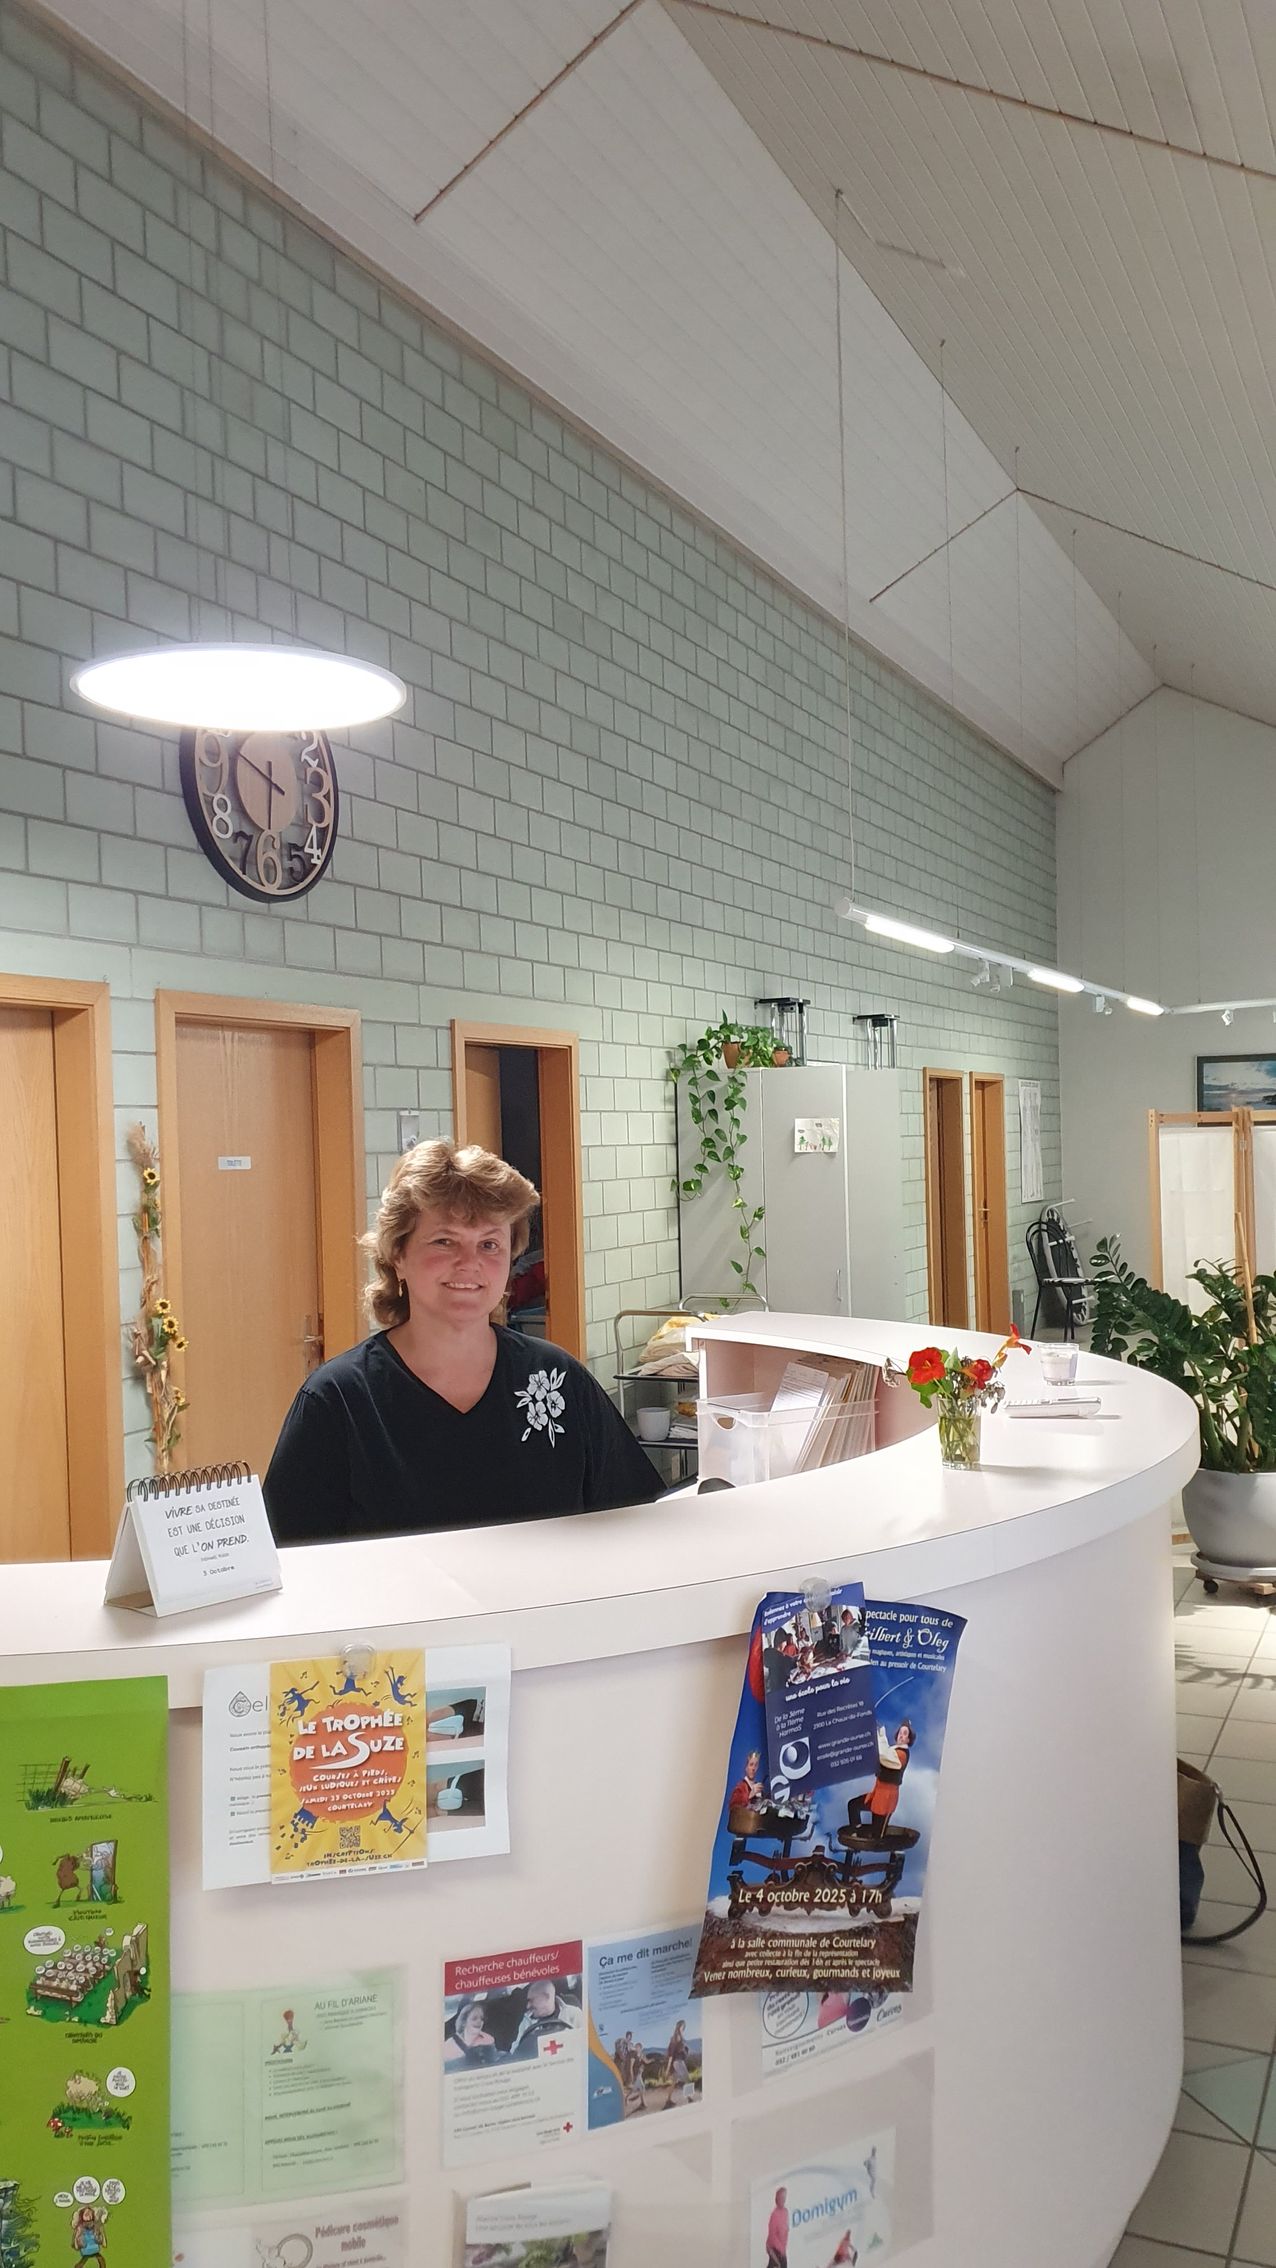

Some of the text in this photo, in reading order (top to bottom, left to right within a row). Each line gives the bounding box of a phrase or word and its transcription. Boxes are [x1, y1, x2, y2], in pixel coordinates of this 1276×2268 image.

[198, 731, 229, 795] 9
[305, 768, 332, 828] 3
[212, 794, 233, 839] 8
[233, 831, 253, 875] 7
[304, 825, 322, 864] 4
[256, 831, 282, 889] 6
[288, 842, 306, 882] 5
[195, 1504, 206, 1514] SA
[208, 1496, 241, 1511] DESTINÉE
[167, 1514, 246, 1538] EST UNE DÉCISION
[173, 1545, 189, 1557] QUE
[192, 1540, 214, 1553] L'ON
[900, 1613, 919, 1623] pour
[921, 1614, 939, 1625] tous
[941, 1618, 954, 1628] de
[918, 1628, 950, 1653] Oleg
[909, 1661, 917, 1669] de
[917, 1662, 948, 1673] Courtelary
[297, 1709, 404, 1736] LE TROPHÉE
[293, 1745, 315, 1761] DE
[321, 1739, 348, 1758] LA
[313, 1771, 350, 1782] COURSES
[321, 1780, 359, 1790] LUDIQUES
[301, 1796, 328, 1805] SAMEDI
[342, 1791, 374, 1800] OCTOBRE
[738, 1888, 883, 1904] Le 4 octobre 2025 à 17h
[599, 1937, 693, 1969] Ça me dit marche!
[730, 1936, 876, 1950] à la salle communale de Courtelary
[455, 1950, 559, 1977] Recherche chauffeurs/
[703, 1968, 901, 1983] Venez nombreux, curieux, gourmands et joyeux
[454, 1964, 560, 1991] chauffeuses bénévoles
[314, 2000, 326, 2011] AU
[328, 1999, 339, 2010] FIL
[792, 2187, 858, 2228] Domigym
